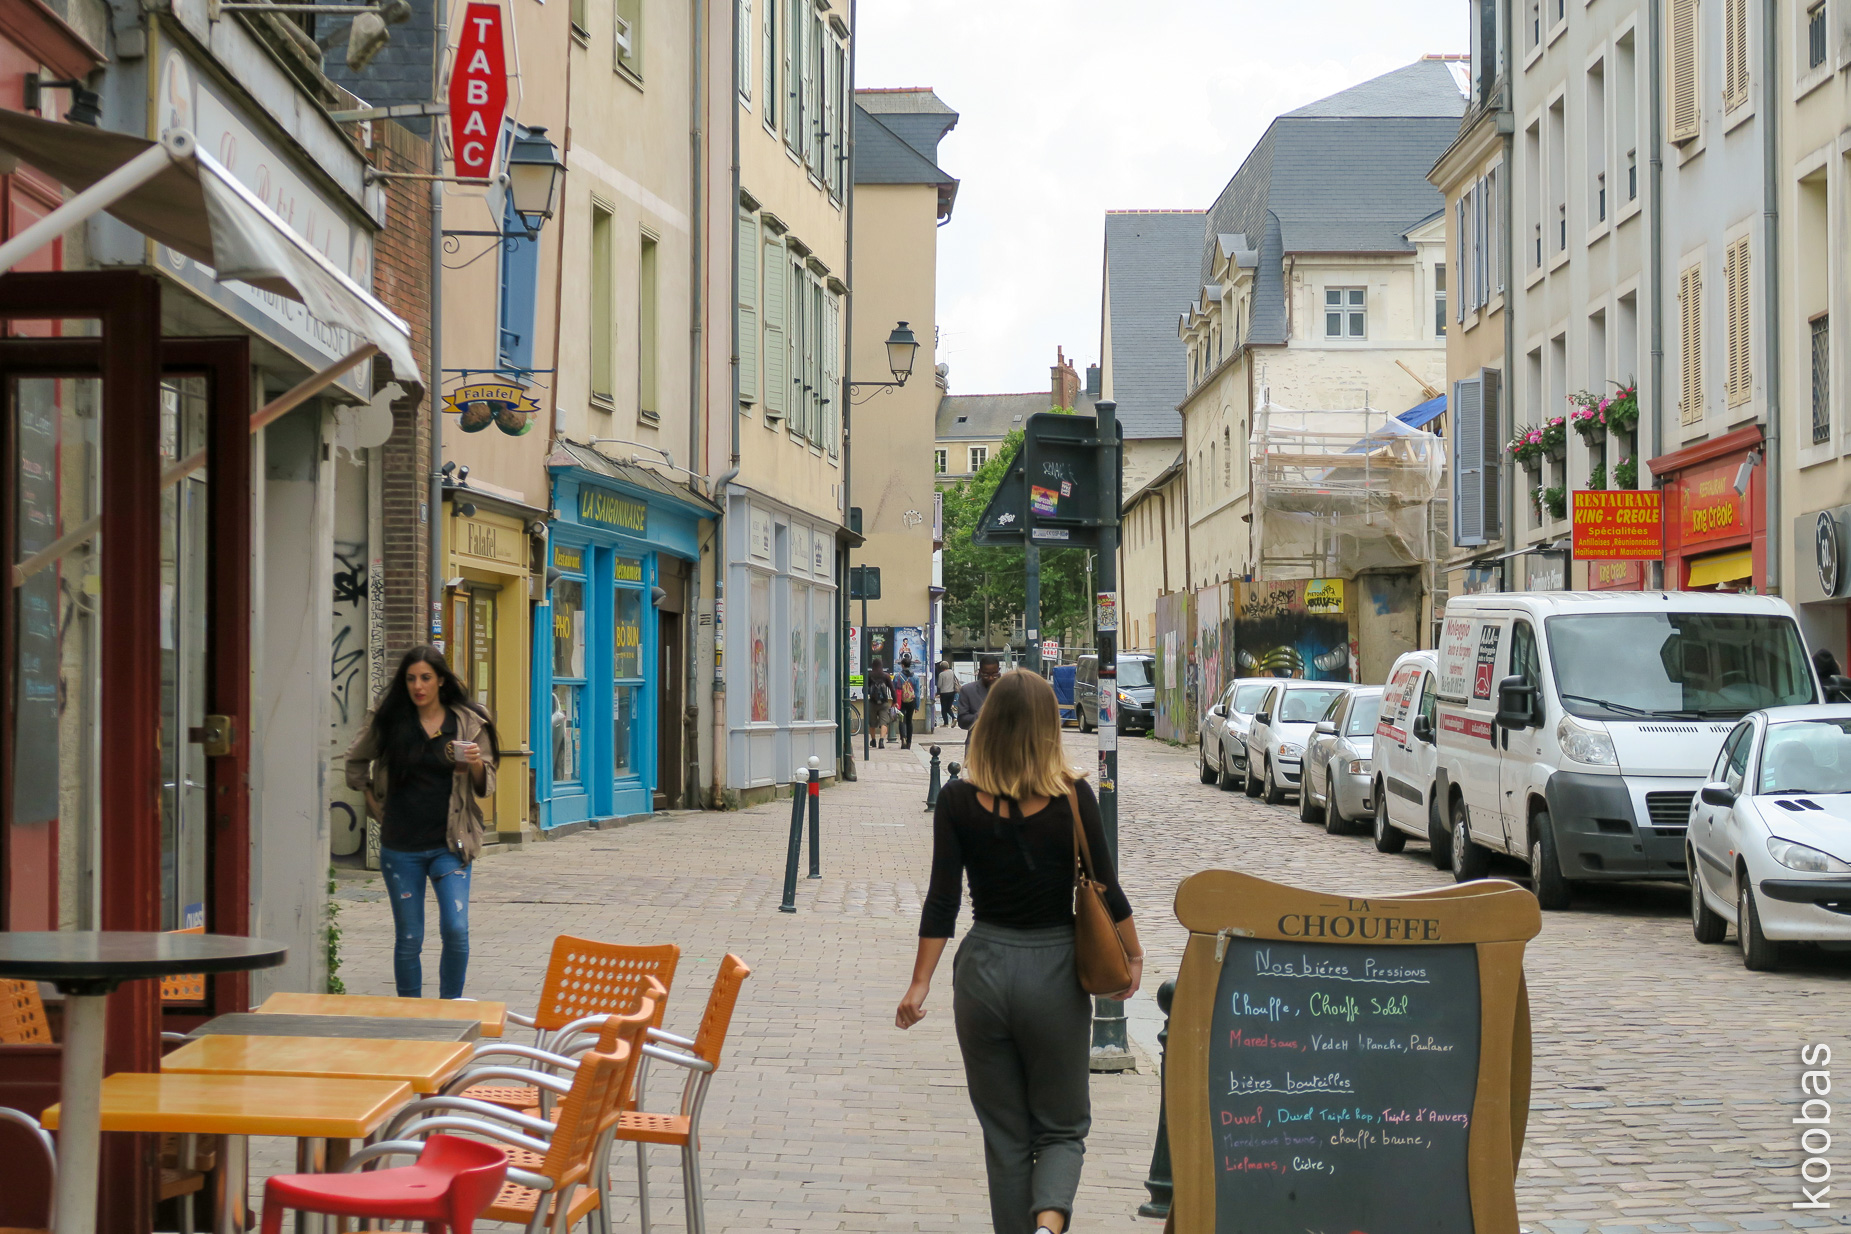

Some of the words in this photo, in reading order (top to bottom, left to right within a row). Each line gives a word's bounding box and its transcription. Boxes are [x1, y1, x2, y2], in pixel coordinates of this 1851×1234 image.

[463, 17, 493, 167] TABAC
[464, 388, 513, 400] Falafel
[1575, 493, 1660, 507] RESTAURANT
[582, 490, 594, 519] LA
[595, 493, 646, 531] SAIGONNAISE
[1574, 508, 1604, 524] KING
[1616, 508, 1660, 524] CREOLE
[467, 522, 497, 558] Falafel
[1588, 526, 1648, 537] Spécialitées
[554, 546, 580, 569] Restaurant
[1609, 548, 1616, 556] et
[1619, 548, 1662, 556] Mauriciennes
[1347, 900, 1371, 912] LA
[1278, 914, 1441, 941] CHOUFFE
[1255, 947, 1293, 974] Nos
[1365, 958, 1427, 977] Pressions
[1310, 991, 1360, 1022] Chouffe
[1371, 995, 1408, 1015] Soleil
[1286, 1071, 1351, 1090] bouteilles
[1277, 1106, 1314, 1123] Duvel
